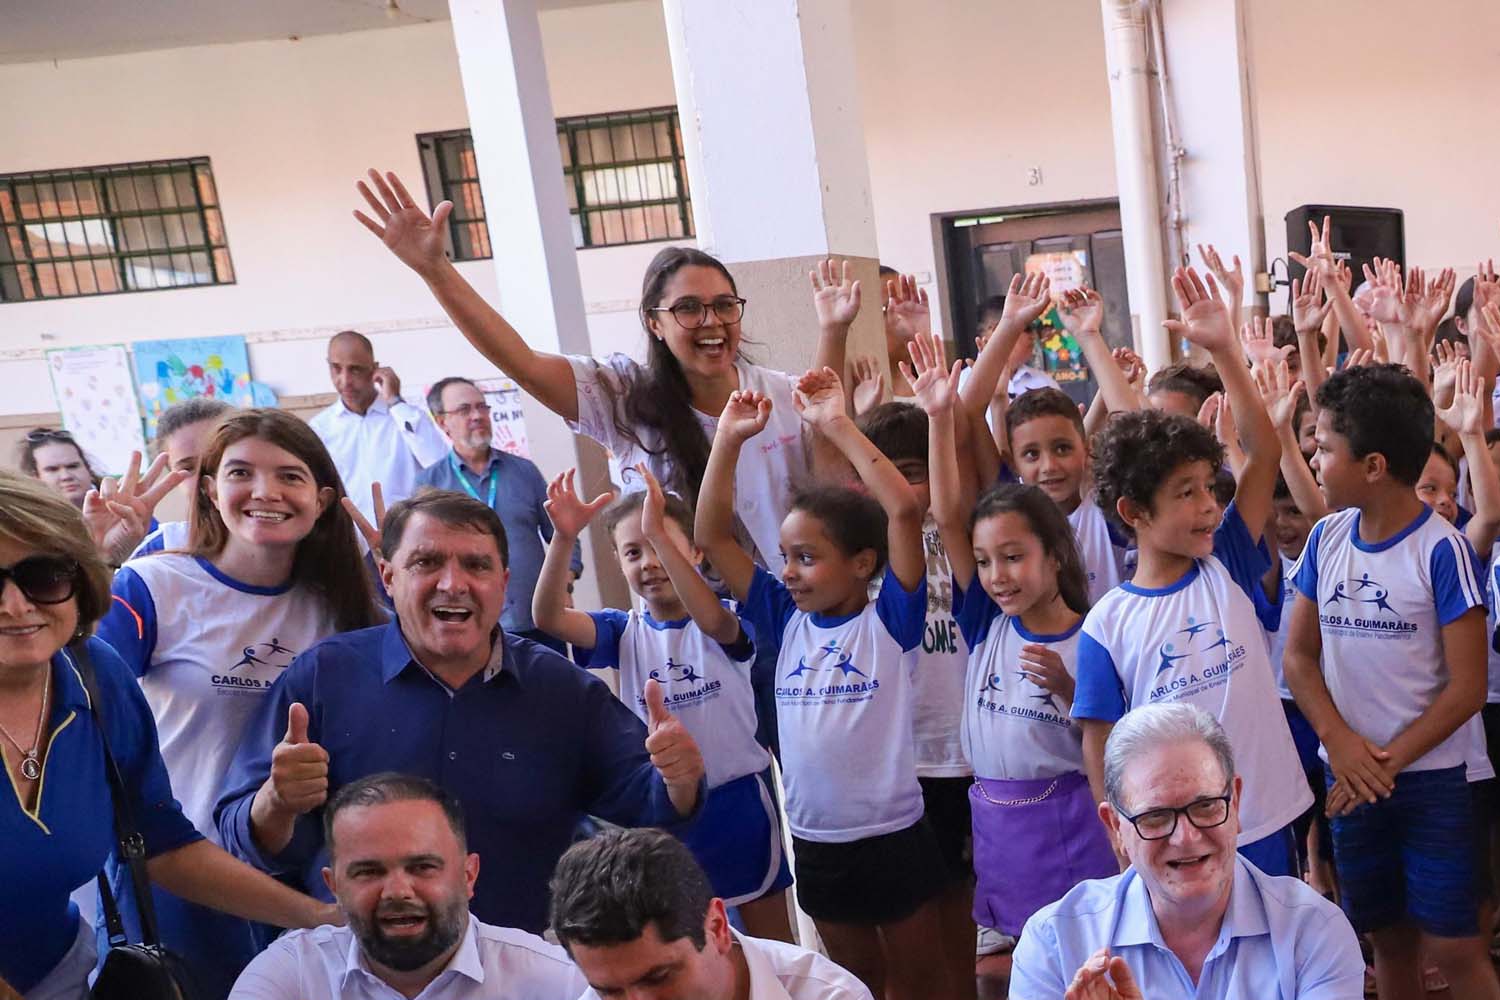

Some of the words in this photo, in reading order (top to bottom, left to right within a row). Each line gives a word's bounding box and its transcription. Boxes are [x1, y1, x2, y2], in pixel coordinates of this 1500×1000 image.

[1354, 618, 1418, 631] GUIMARÃES
[211, 675, 261, 688] CARLOS
[1010, 706, 1072, 727] GUIMARÃES
